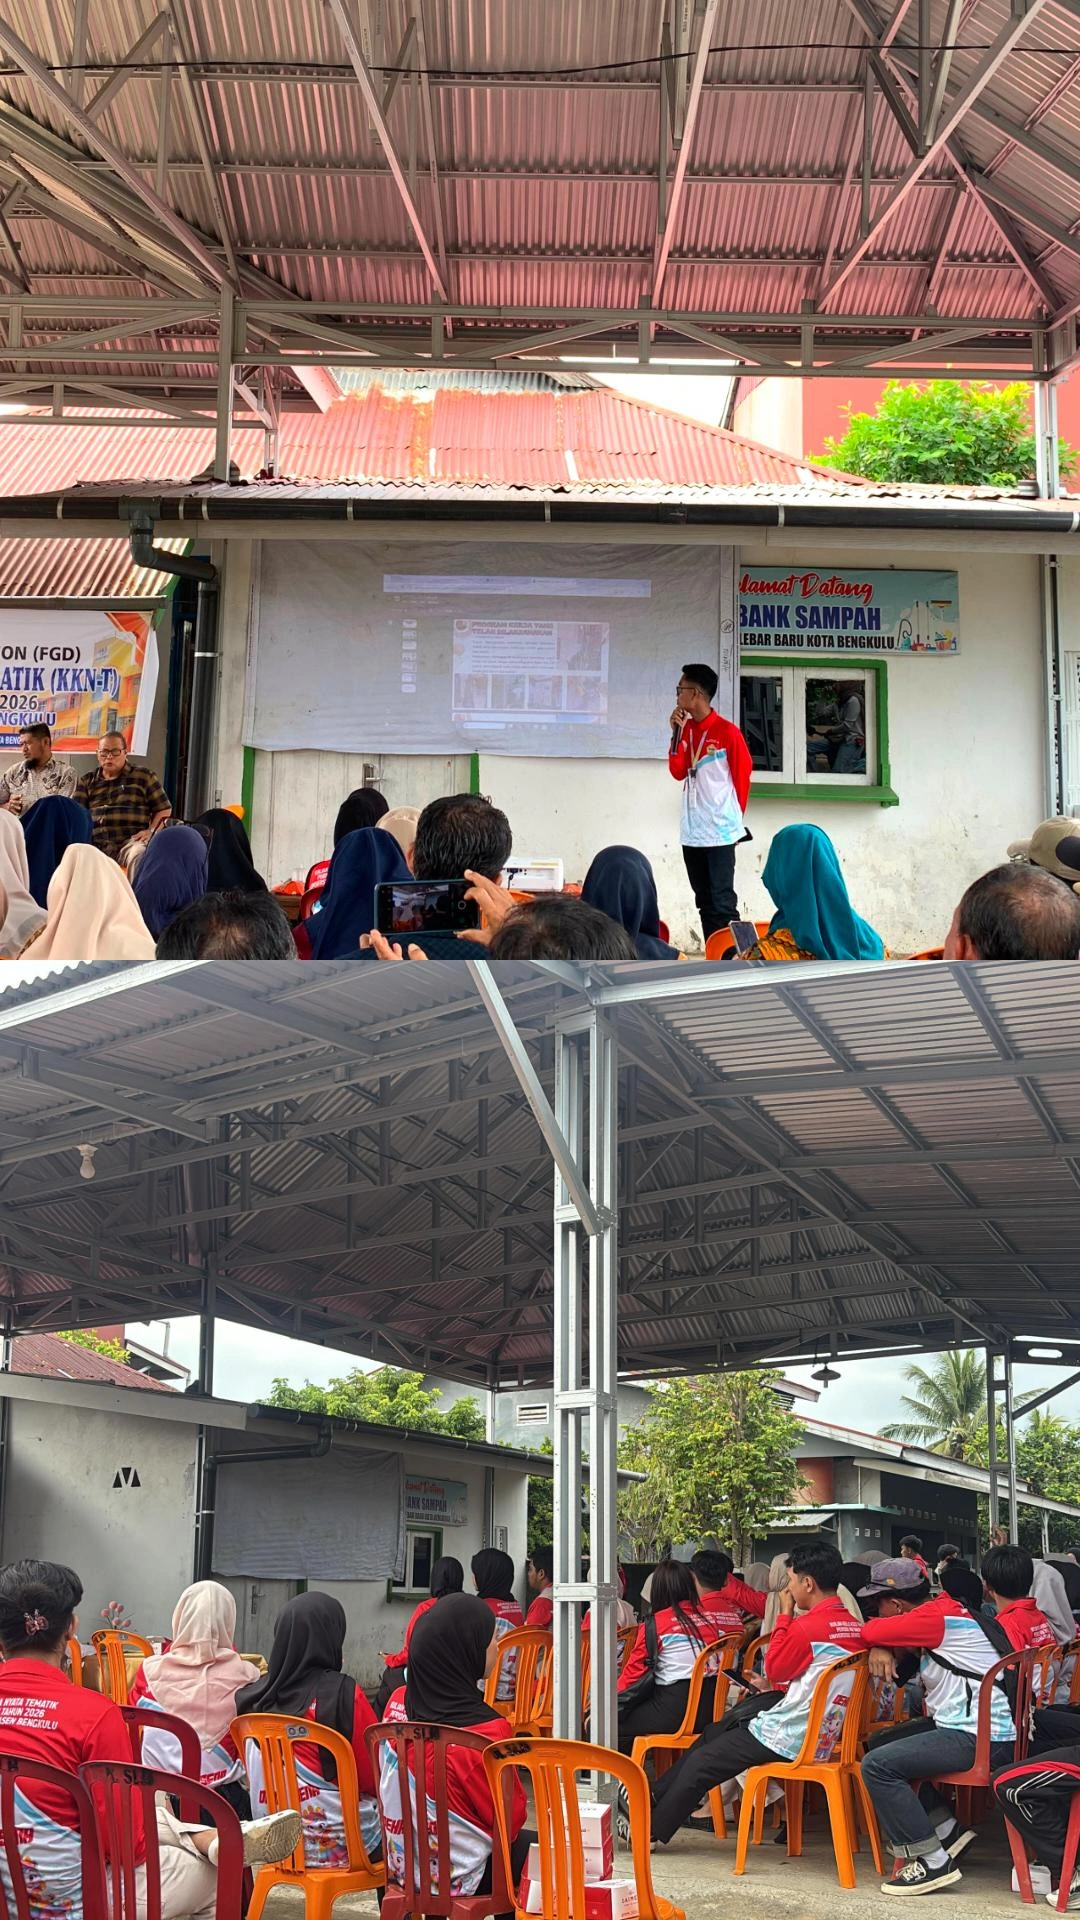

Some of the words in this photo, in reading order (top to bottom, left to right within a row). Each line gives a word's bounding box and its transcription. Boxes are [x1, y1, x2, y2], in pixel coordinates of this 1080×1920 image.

[799, 573, 873, 606] Datang
[739, 604, 791, 629] BANK
[795, 605, 882, 631] SAMPAH
[774, 634, 804, 648] BARU
[807, 635, 834, 648] KOTA
[837, 636, 895, 650] BENGKULU
[33, 646, 81, 664] (FGD)
[51, 667, 119, 697] (KKN-T)
[0, 695, 38, 710] 2026
[25, 1698, 59, 1710] TEMATIK
[24, 1708, 46, 1718] 2026
[16, 1717, 59, 1730] BENGKULU
